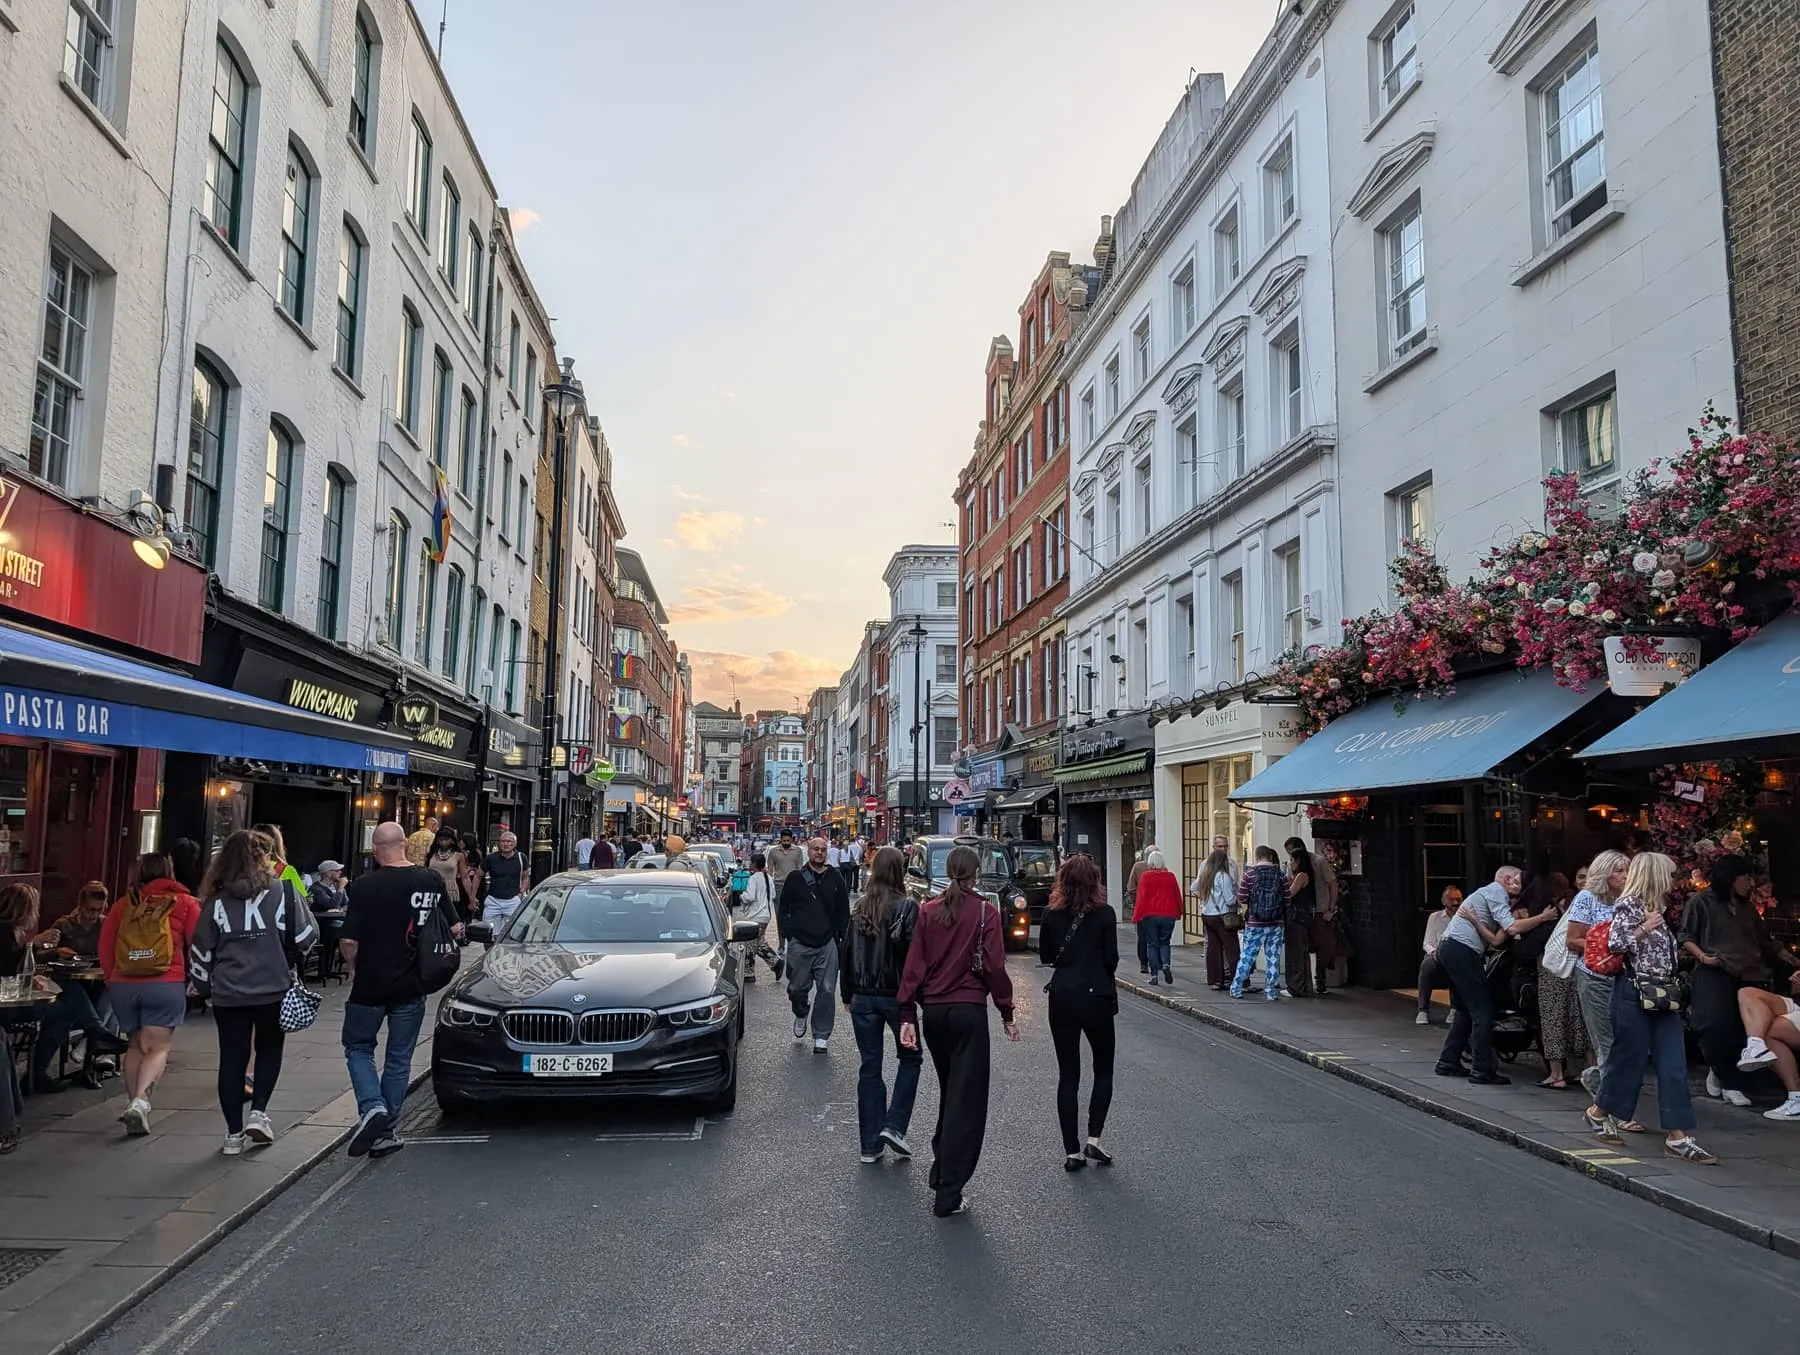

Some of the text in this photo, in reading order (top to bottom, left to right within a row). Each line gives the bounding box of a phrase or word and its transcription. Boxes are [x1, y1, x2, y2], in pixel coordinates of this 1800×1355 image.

[5, 550, 45, 588] STREET
[4, 692, 109, 735] PASTA BAR
[289, 679, 359, 722] WINGMANS
[1205, 709, 1239, 728] SUNSPEL
[536, 1058, 608, 1071] 182-C-6262
